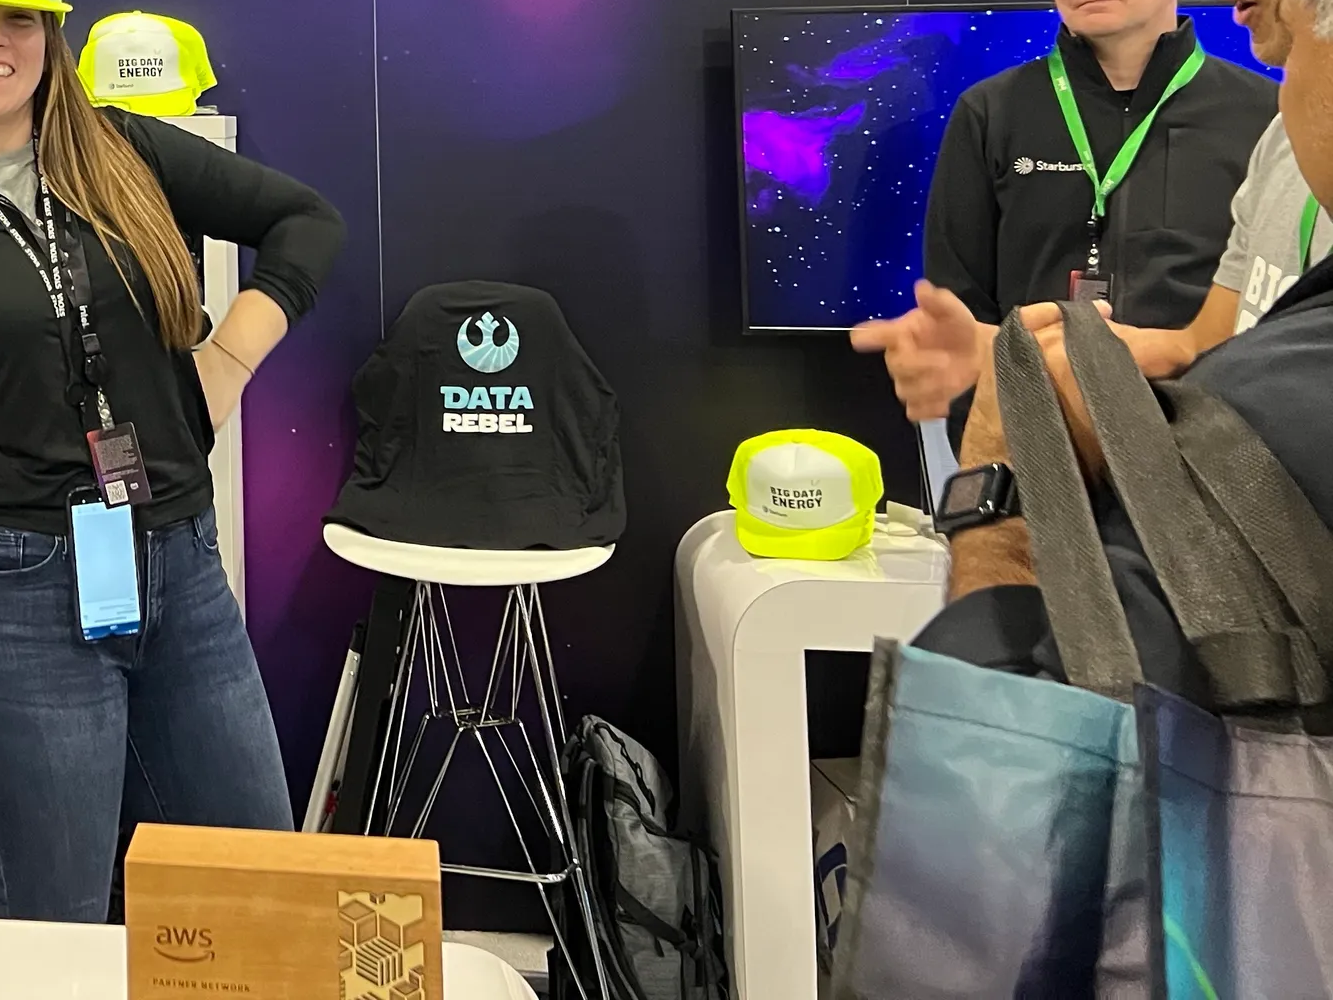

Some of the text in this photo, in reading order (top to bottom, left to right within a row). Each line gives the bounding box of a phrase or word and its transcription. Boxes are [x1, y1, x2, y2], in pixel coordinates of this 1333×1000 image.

[118, 58, 164, 67] BIG DATA
[119, 68, 163, 78] ENERGY
[1036, 160, 1084, 171] Starburs
[440, 386, 534, 409] DATA
[443, 412, 533, 433] REBEL
[770, 486, 822, 498] BIG DATA
[772, 495, 822, 509] ENERGY
[155, 925, 213, 948] aws
[152, 977, 250, 992] PARTNER NETWORK
